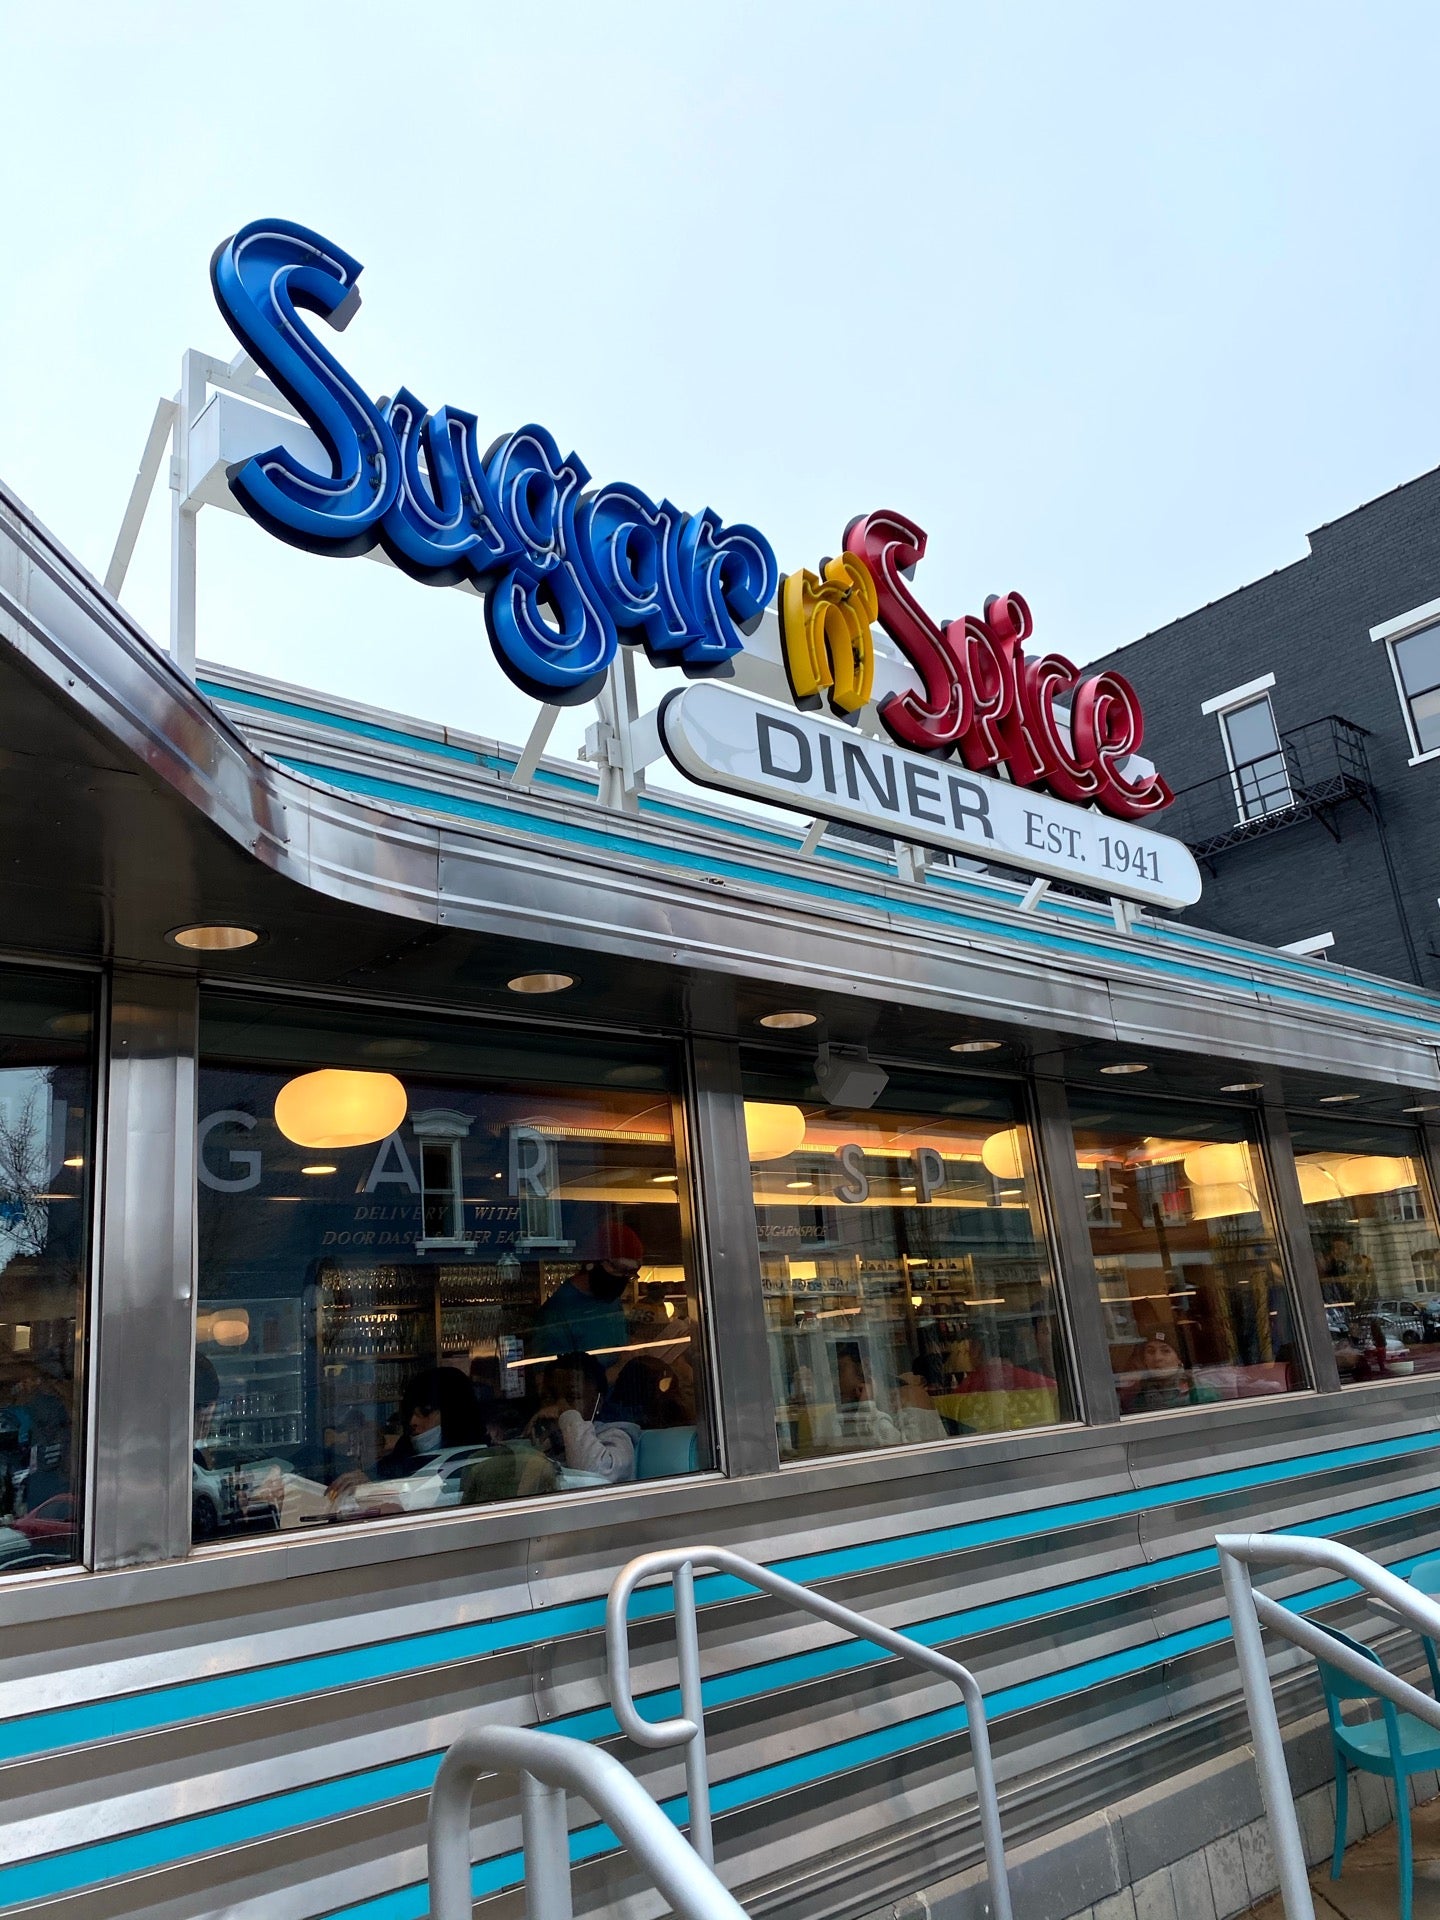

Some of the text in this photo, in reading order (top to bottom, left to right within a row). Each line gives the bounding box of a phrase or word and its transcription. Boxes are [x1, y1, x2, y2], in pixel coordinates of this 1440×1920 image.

[210, 218, 778, 706] Sugar
[844, 509, 1175, 822] Spice
[755, 712, 1164, 884] DINER EST. 1941
[353, 1206, 521, 1221] DELIVERY WITH
